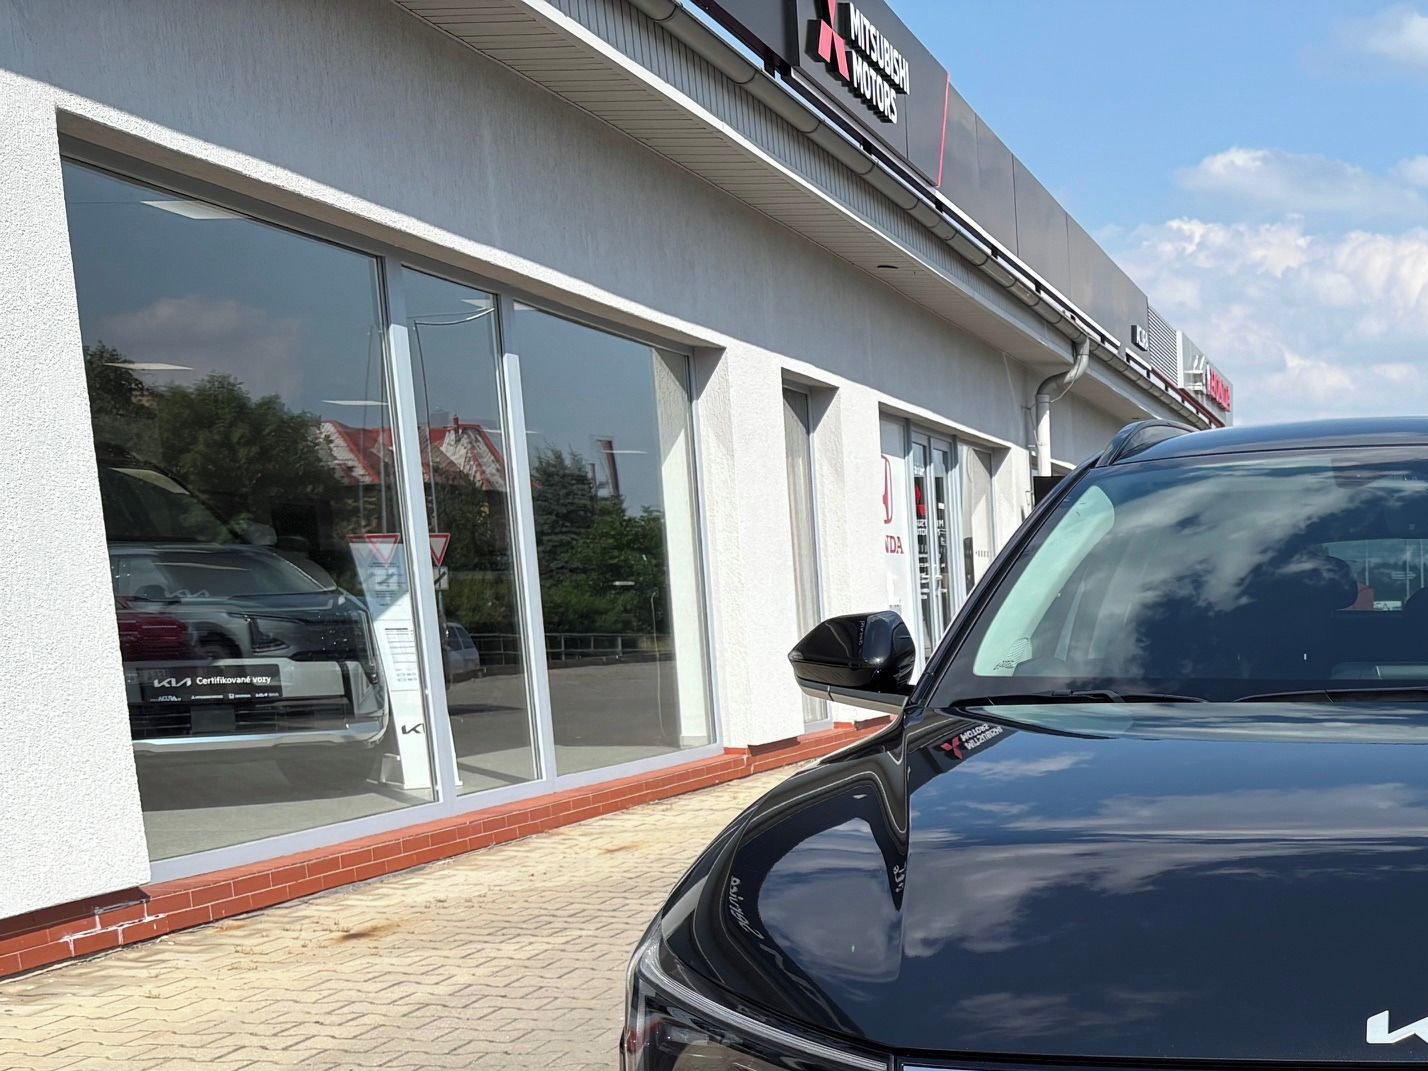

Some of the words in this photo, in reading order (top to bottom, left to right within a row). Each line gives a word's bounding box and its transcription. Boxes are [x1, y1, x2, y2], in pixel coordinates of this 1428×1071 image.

[850, 3, 910, 95] MITSUBISHI
[852, 51, 897, 124] MOTORS
[885, 535, 904, 554] NDA
